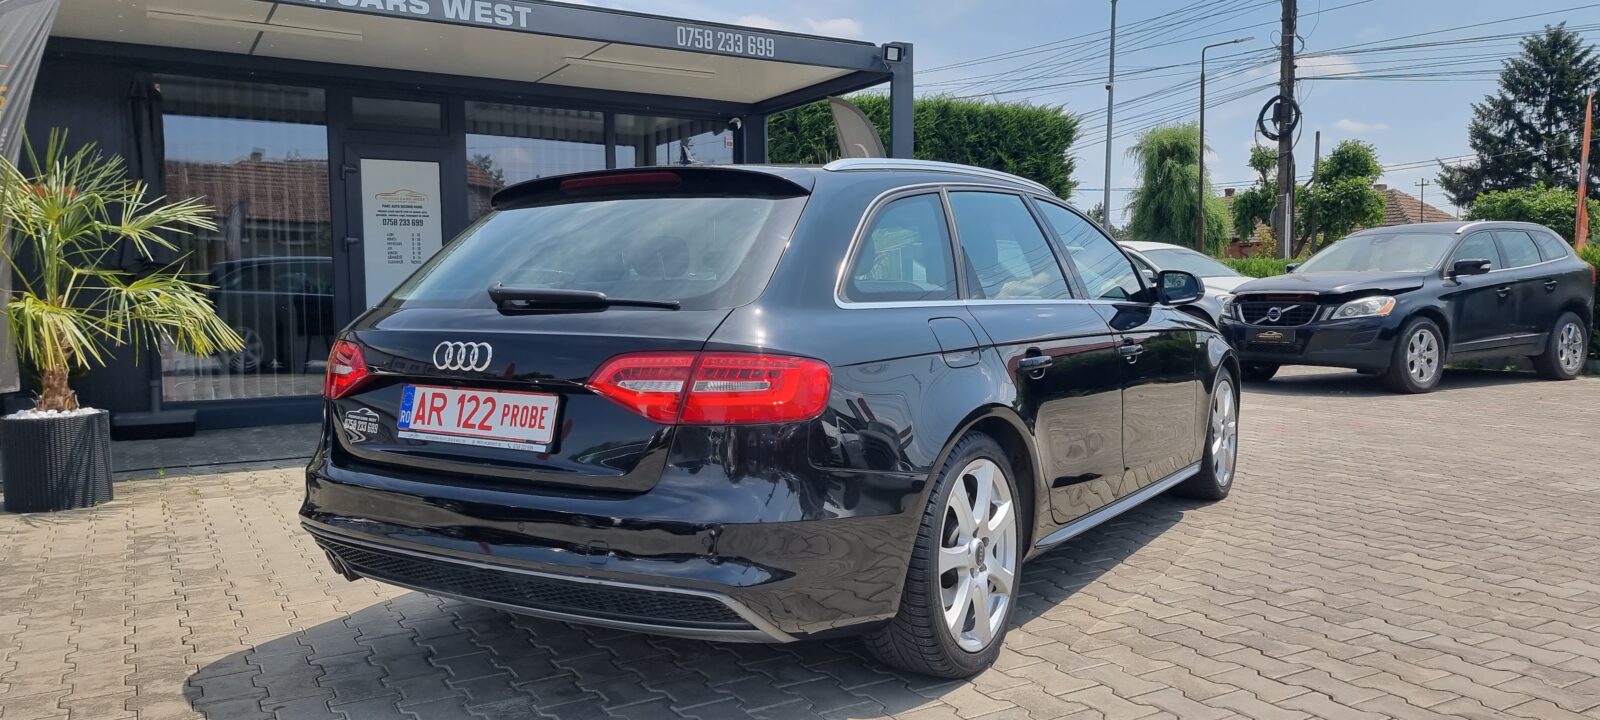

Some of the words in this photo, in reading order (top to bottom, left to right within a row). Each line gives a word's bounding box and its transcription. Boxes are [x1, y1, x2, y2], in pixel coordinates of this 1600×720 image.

[443, 0, 532, 28] WEST
[676, 26, 713, 49] 0758
[717, 31, 743, 53] 233
[747, 35, 775, 57] 699
[383, 218, 397, 226] 0758
[399, 218, 410, 226] 233
[411, 219, 423, 227] 699
[399, 410, 411, 424] RO
[413, 392, 448, 426] AR
[457, 394, 497, 431] 122
[501, 404, 549, 430] PROBE
